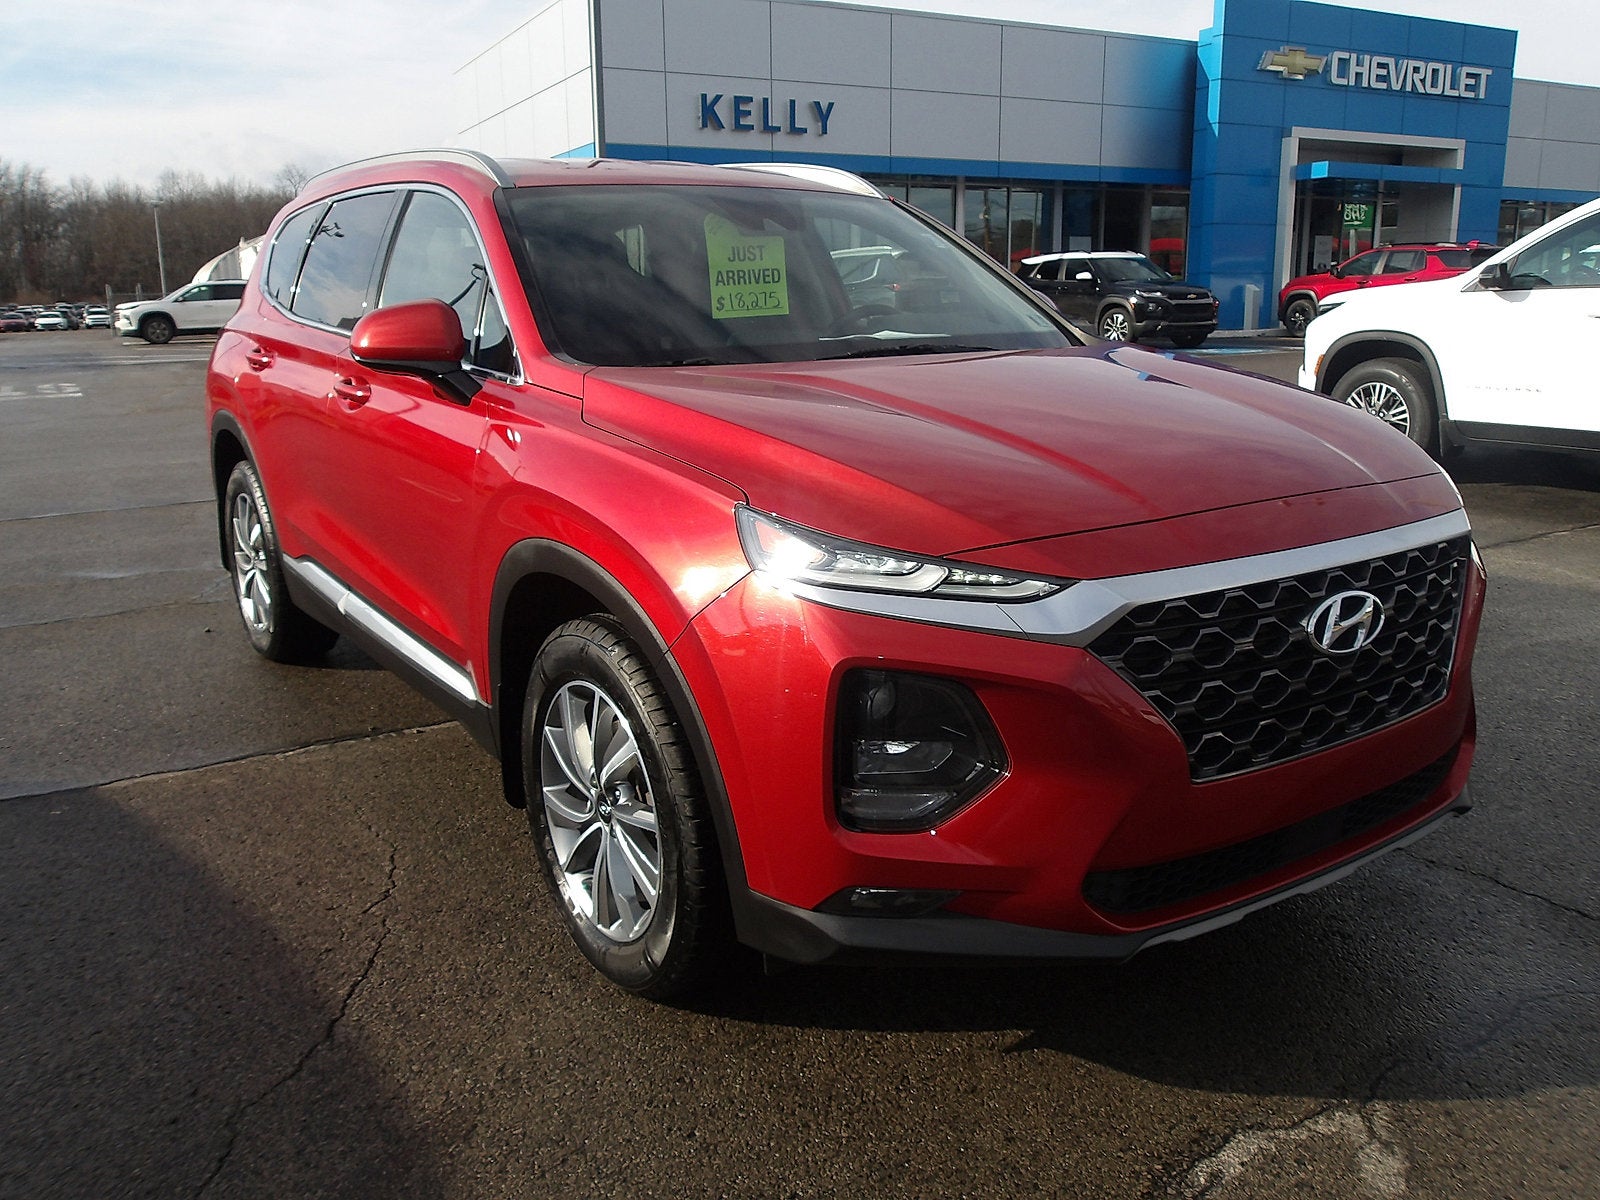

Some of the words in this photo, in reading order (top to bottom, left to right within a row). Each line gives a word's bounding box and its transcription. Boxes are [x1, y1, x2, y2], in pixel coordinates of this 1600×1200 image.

[1330, 51, 1493, 99] CHEVROLET
[700, 92, 835, 135] KELLY
[728, 245, 764, 262] JUST
[715, 268, 781, 286] ARRIVED
[716, 291, 781, 312] $18,275
